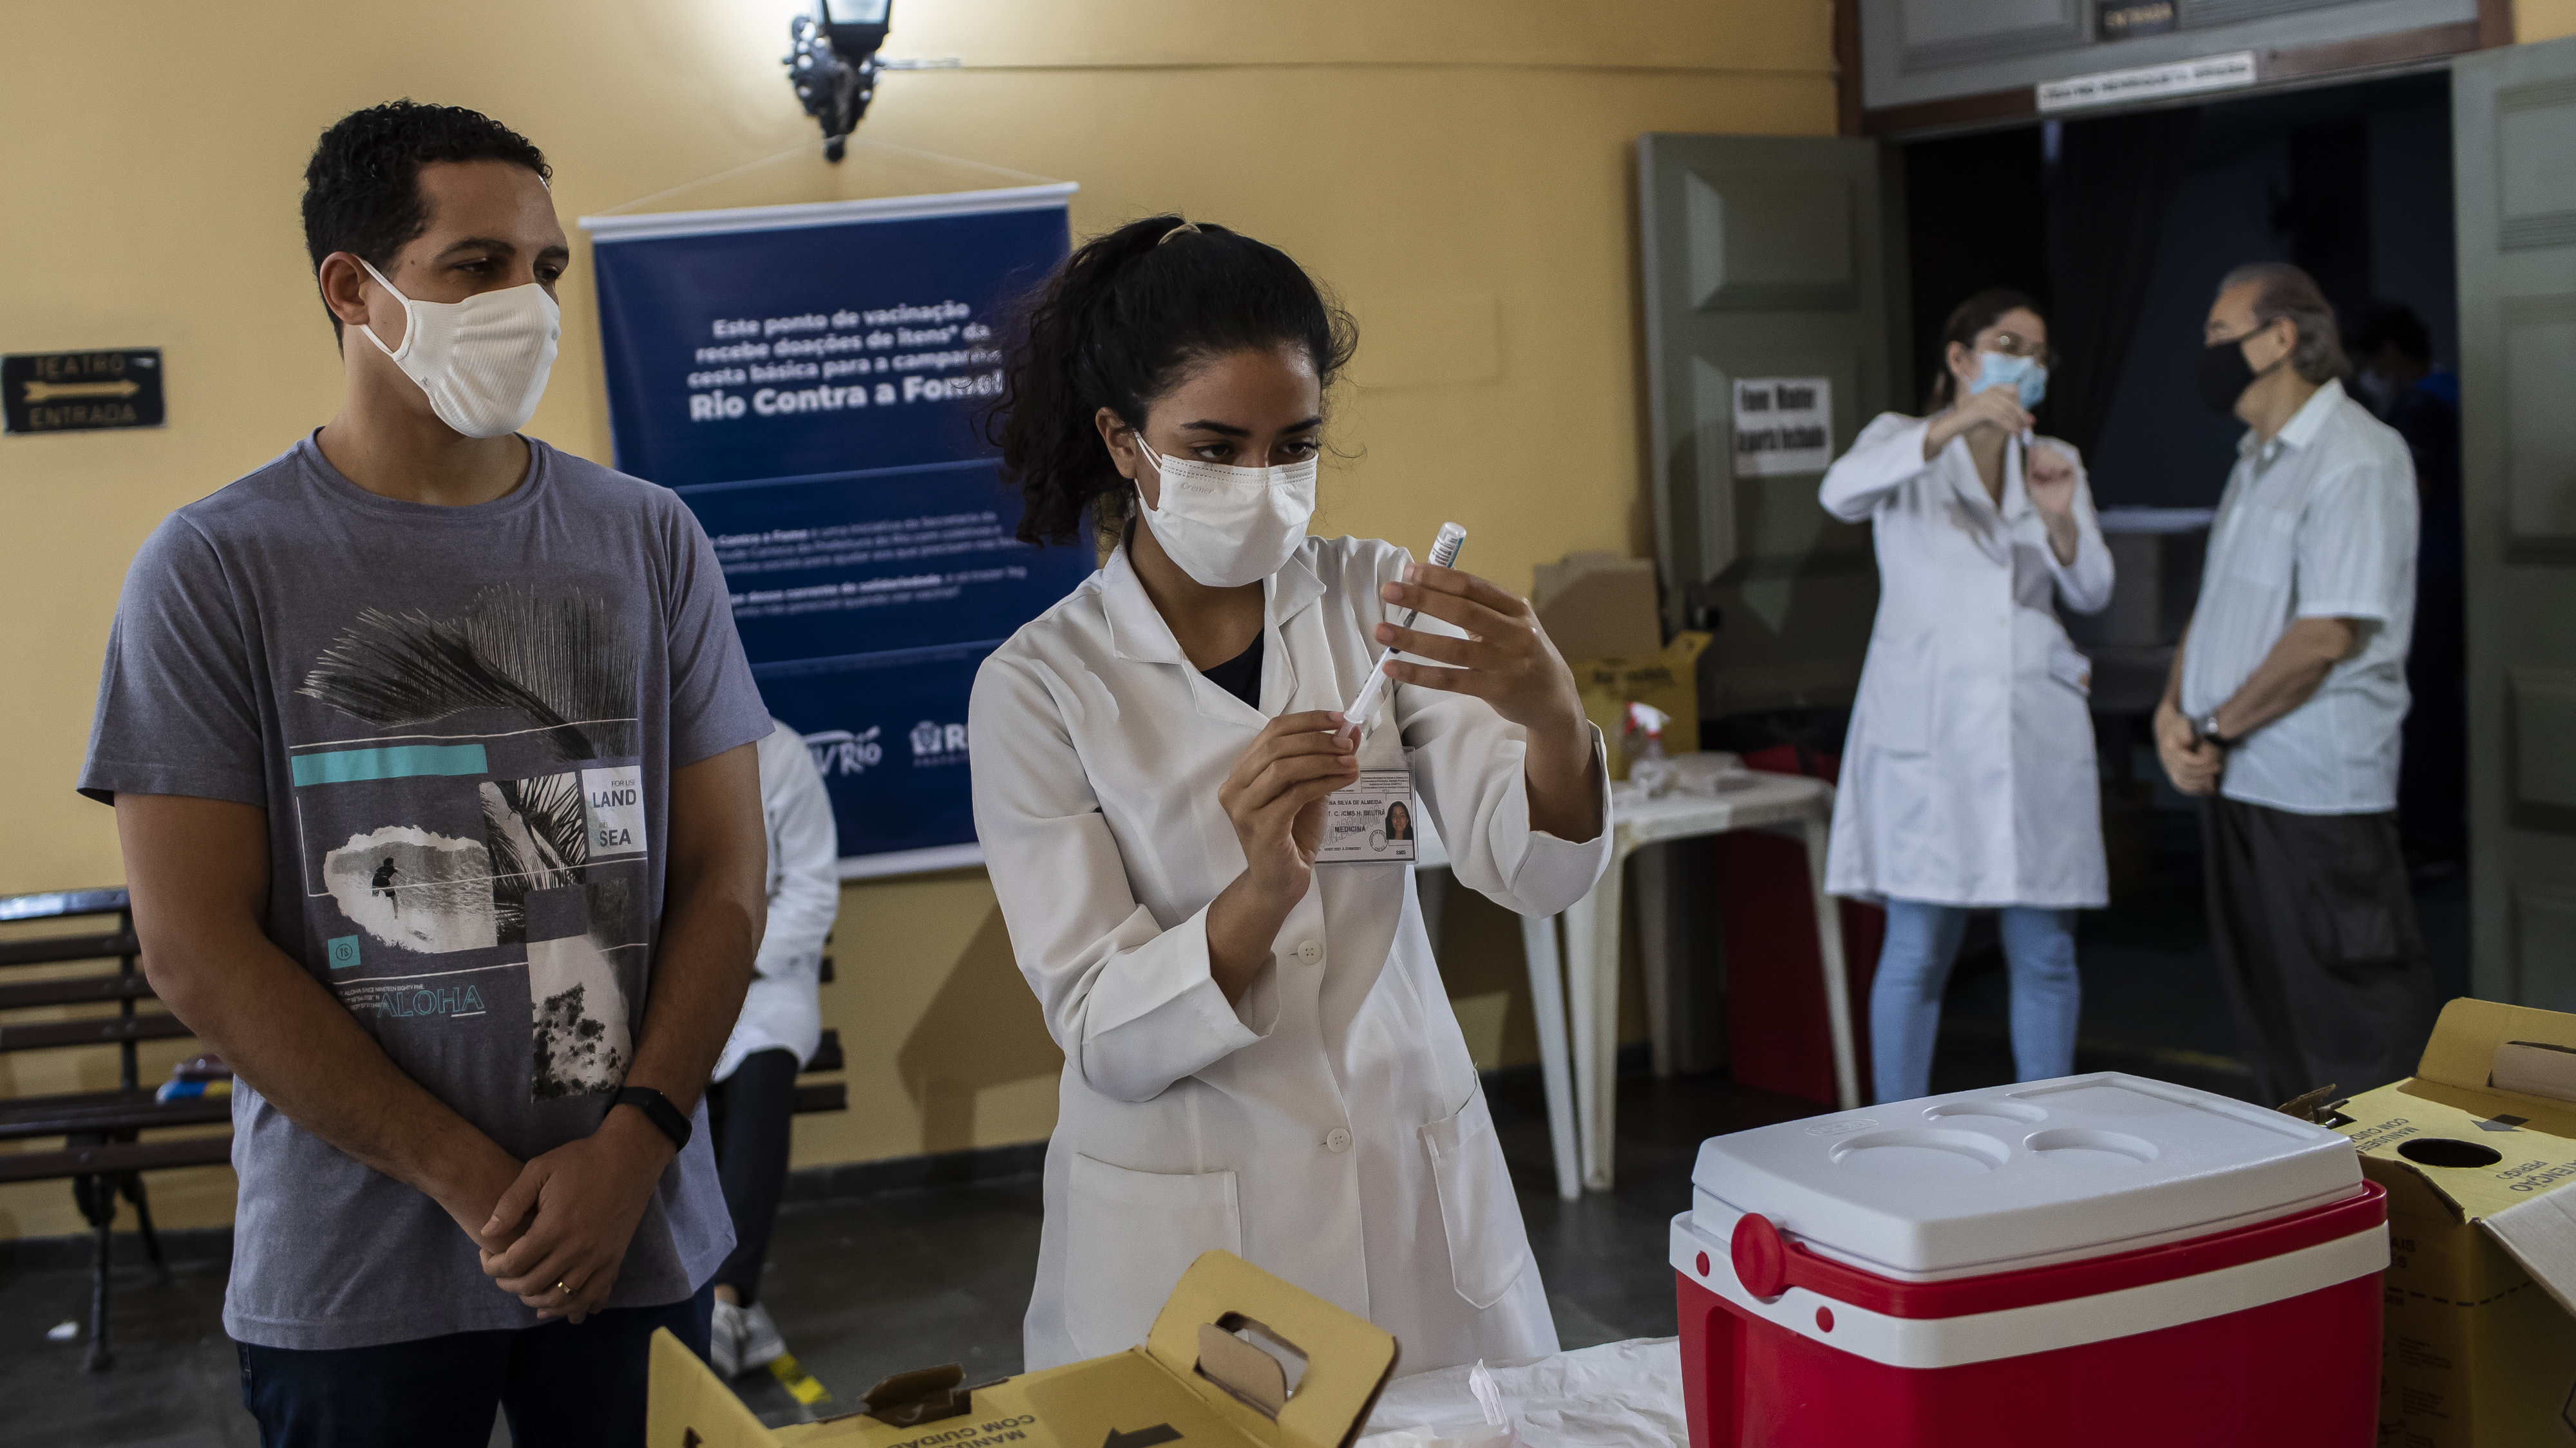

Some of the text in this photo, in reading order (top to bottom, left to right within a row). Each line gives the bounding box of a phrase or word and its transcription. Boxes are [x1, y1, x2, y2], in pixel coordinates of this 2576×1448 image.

[713, 301, 969, 338] Este ponto de vacinação
[696, 341, 770, 364] recebe
[774, 334, 863, 358] doações
[866, 330, 895, 350] de
[35, 354, 126, 380] TEATRO
[687, 368, 746, 388] cesta
[750, 361, 819, 382] básica
[822, 357, 871, 380] para
[874, 356, 889, 373] a
[689, 389, 746, 422] Rio
[752, 384, 868, 415] Contra
[874, 382, 897, 404] a
[30, 403, 137, 428] ENTRADA
[592, 789, 636, 808] LAND
[600, 828, 631, 847] SEA
[377, 985, 484, 1019] ALOHA
[2349, 1118, 2409, 1143] COM CUID
[2356, 1127, 2420, 1151] MANUSEIE
[2496, 1160, 2548, 1180] PERIGO
[981, 1415, 1036, 1433] COM
